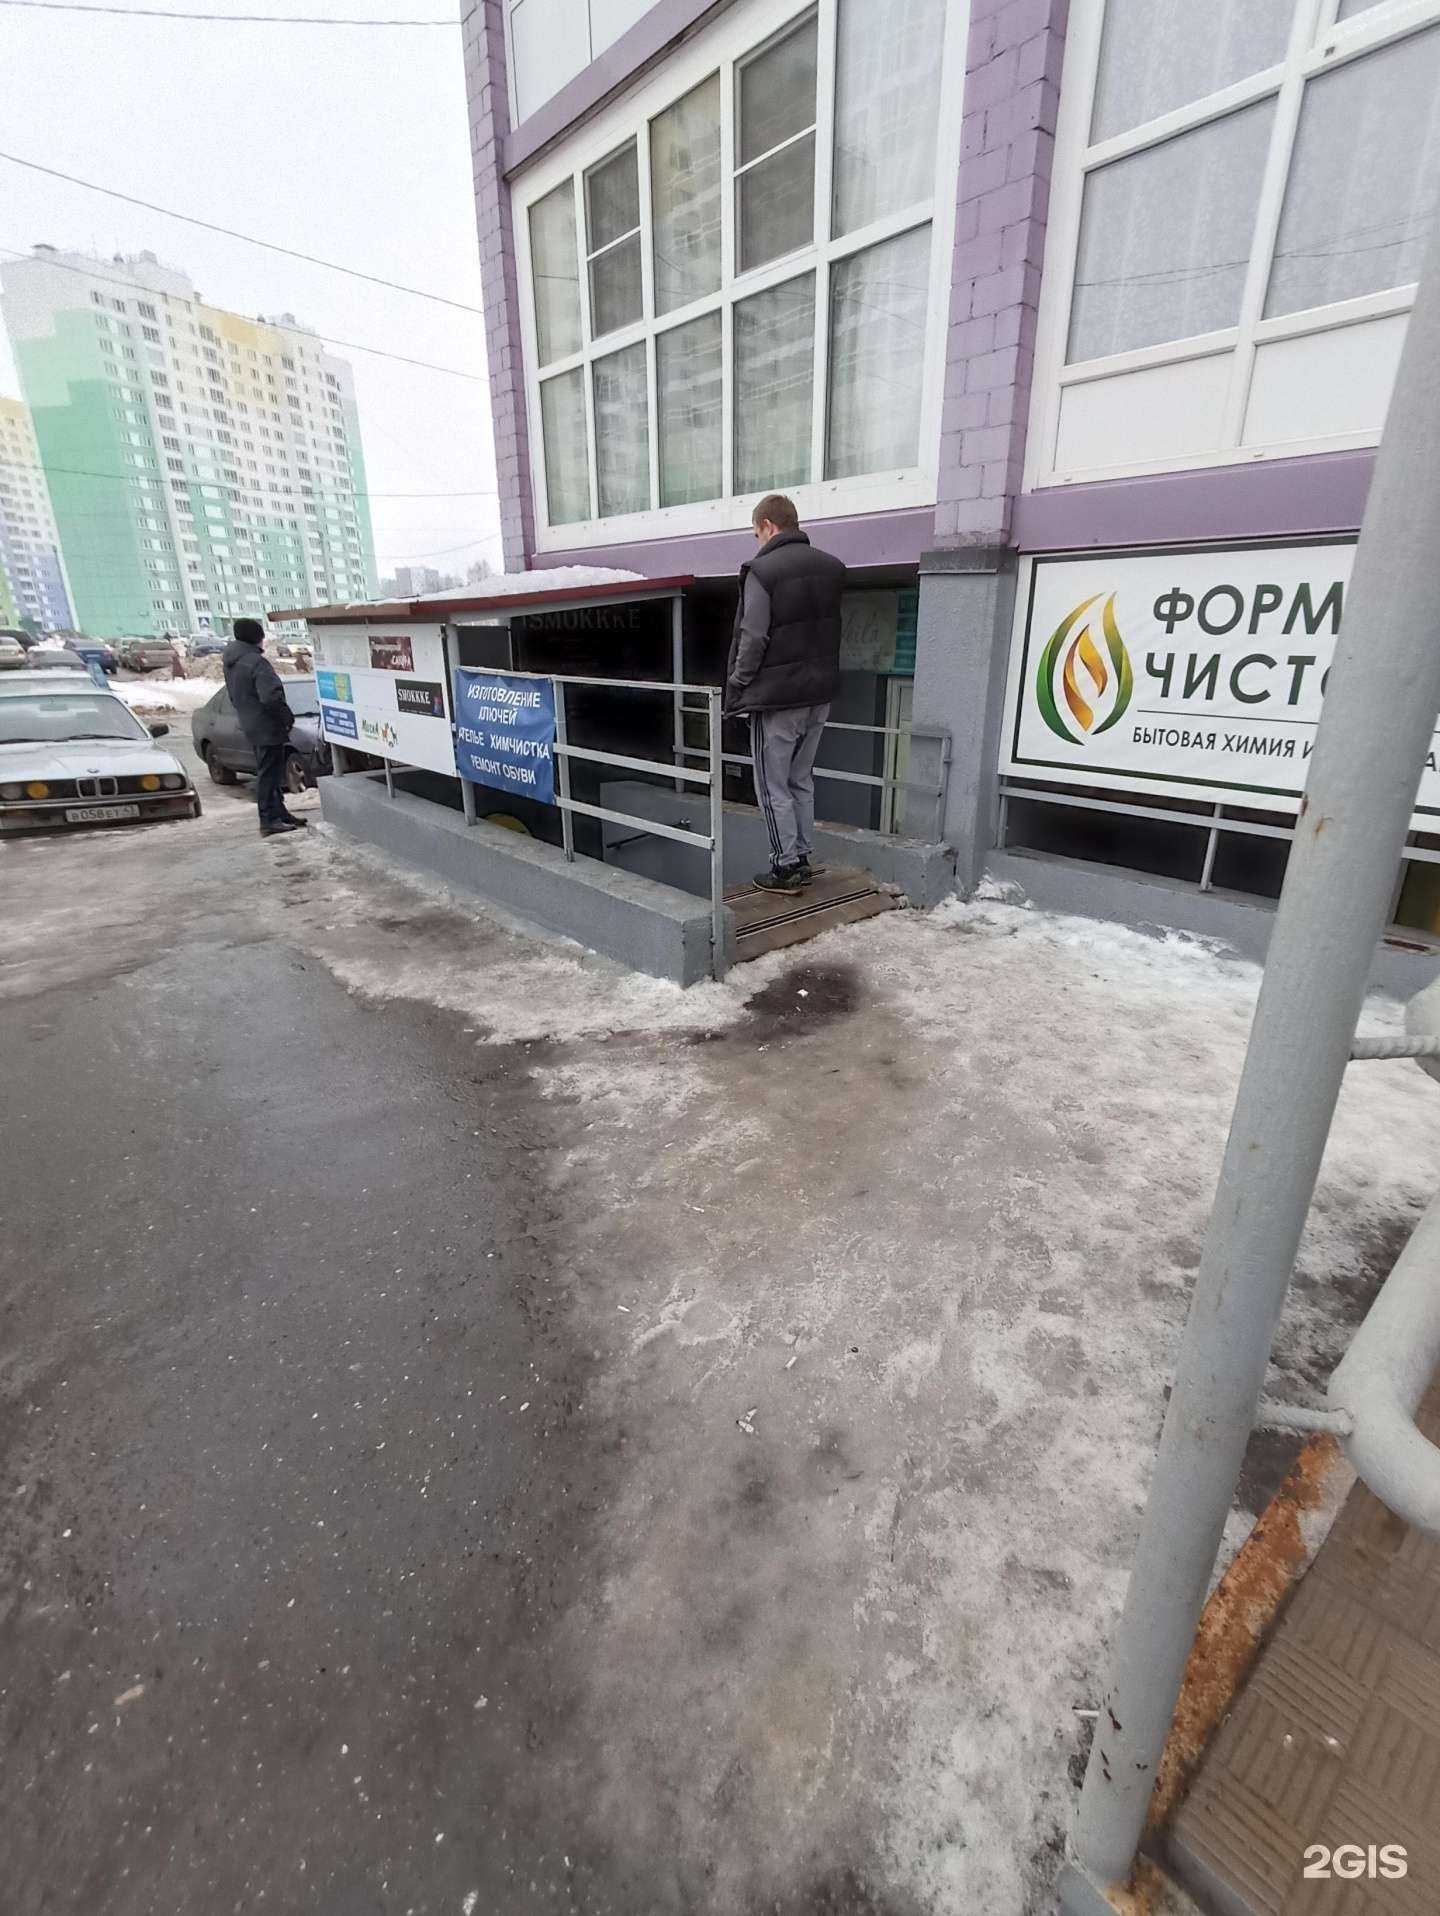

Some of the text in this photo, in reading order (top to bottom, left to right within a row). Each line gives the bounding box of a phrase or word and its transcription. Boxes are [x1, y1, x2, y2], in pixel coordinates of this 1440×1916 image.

[1145, 652, 1331, 706] ЧИСТ
[467, 683, 541, 708] ИЗГОТОВЛЕНИЕ
[478, 706, 518, 726] КЛЮЧЕЙ
[458, 726, 551, 760] АТЕЛЬЕ ХИМЧИСТКА
[1133, 726, 1217, 751] БЫТОВАЯ
[1221, 734, 1296, 760] ХИМИЯ
[470, 754, 537, 785] РЕМОНТ ОБУВИ
